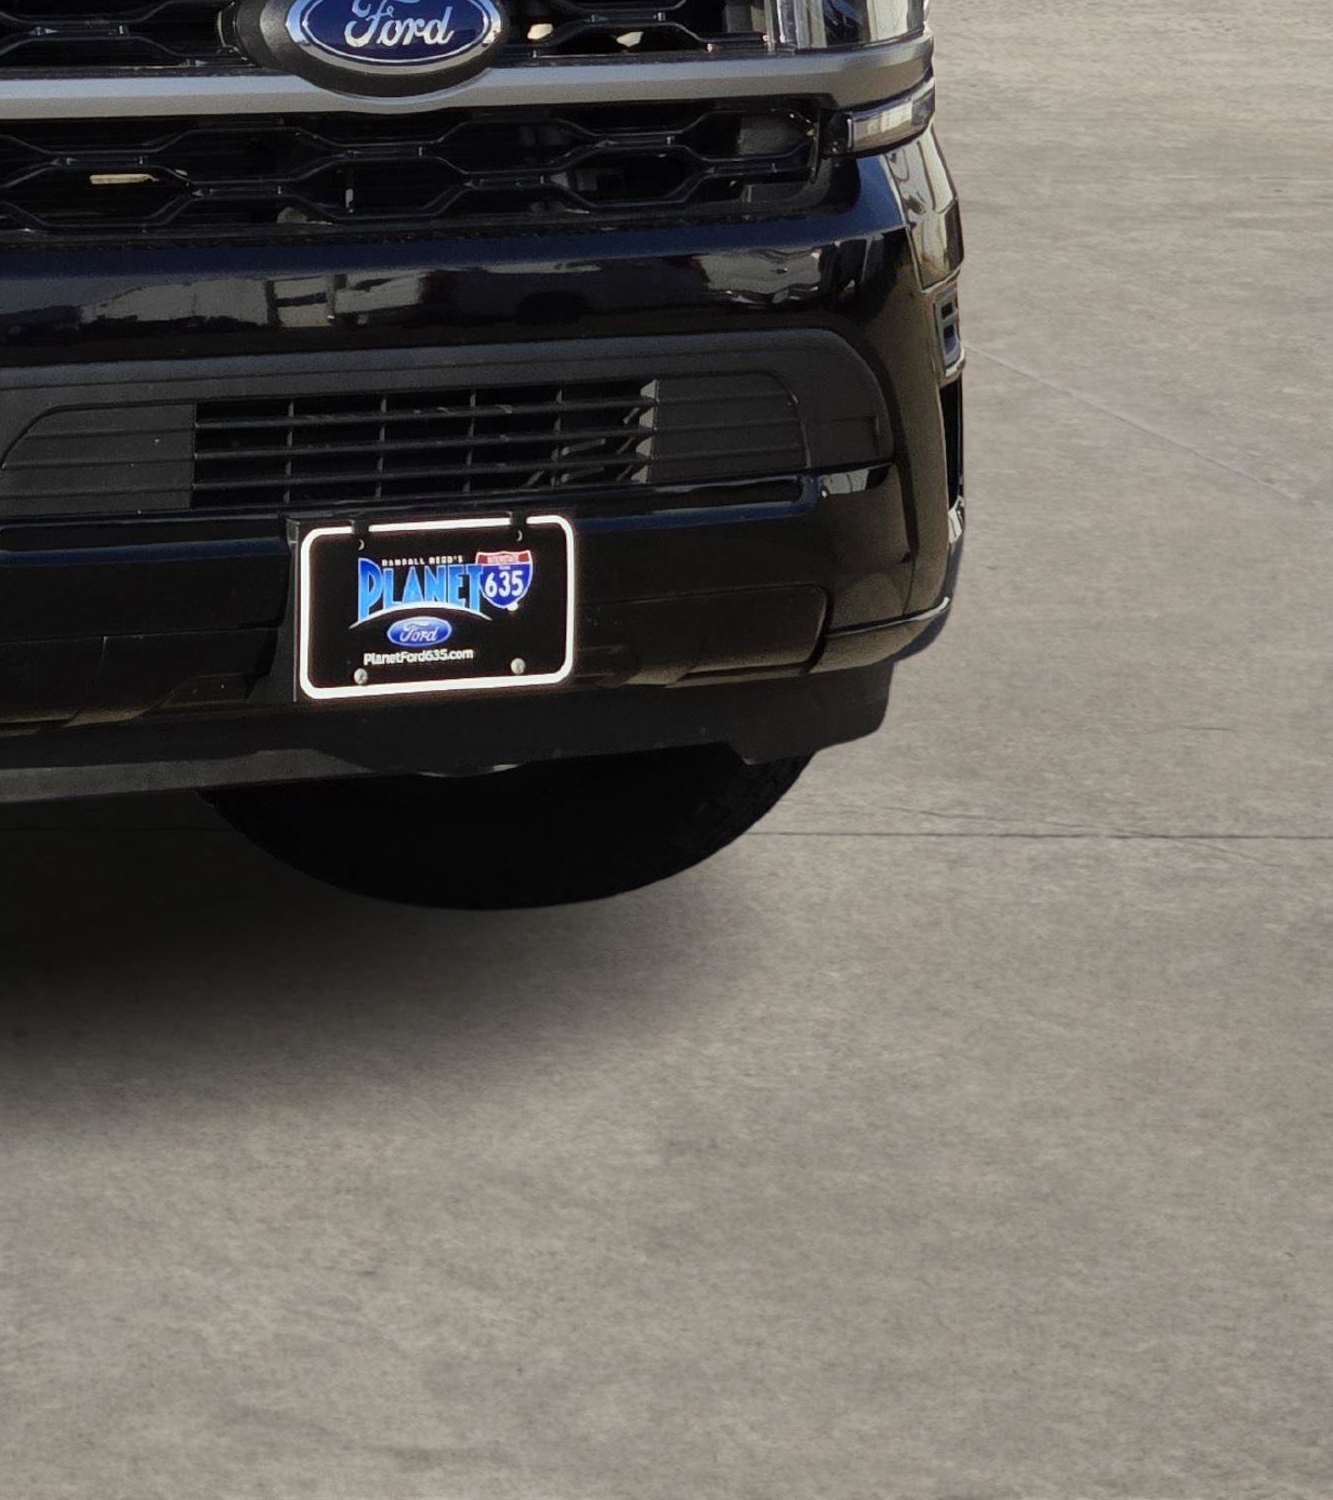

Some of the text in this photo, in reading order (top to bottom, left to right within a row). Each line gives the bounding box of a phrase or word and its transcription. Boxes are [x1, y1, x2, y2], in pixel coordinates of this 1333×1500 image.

[358, 556, 482, 621] PLANET
[485, 570, 524, 597] 635
[399, 621, 439, 643] Ford
[362, 648, 475, 666] PlanetFord635.com
